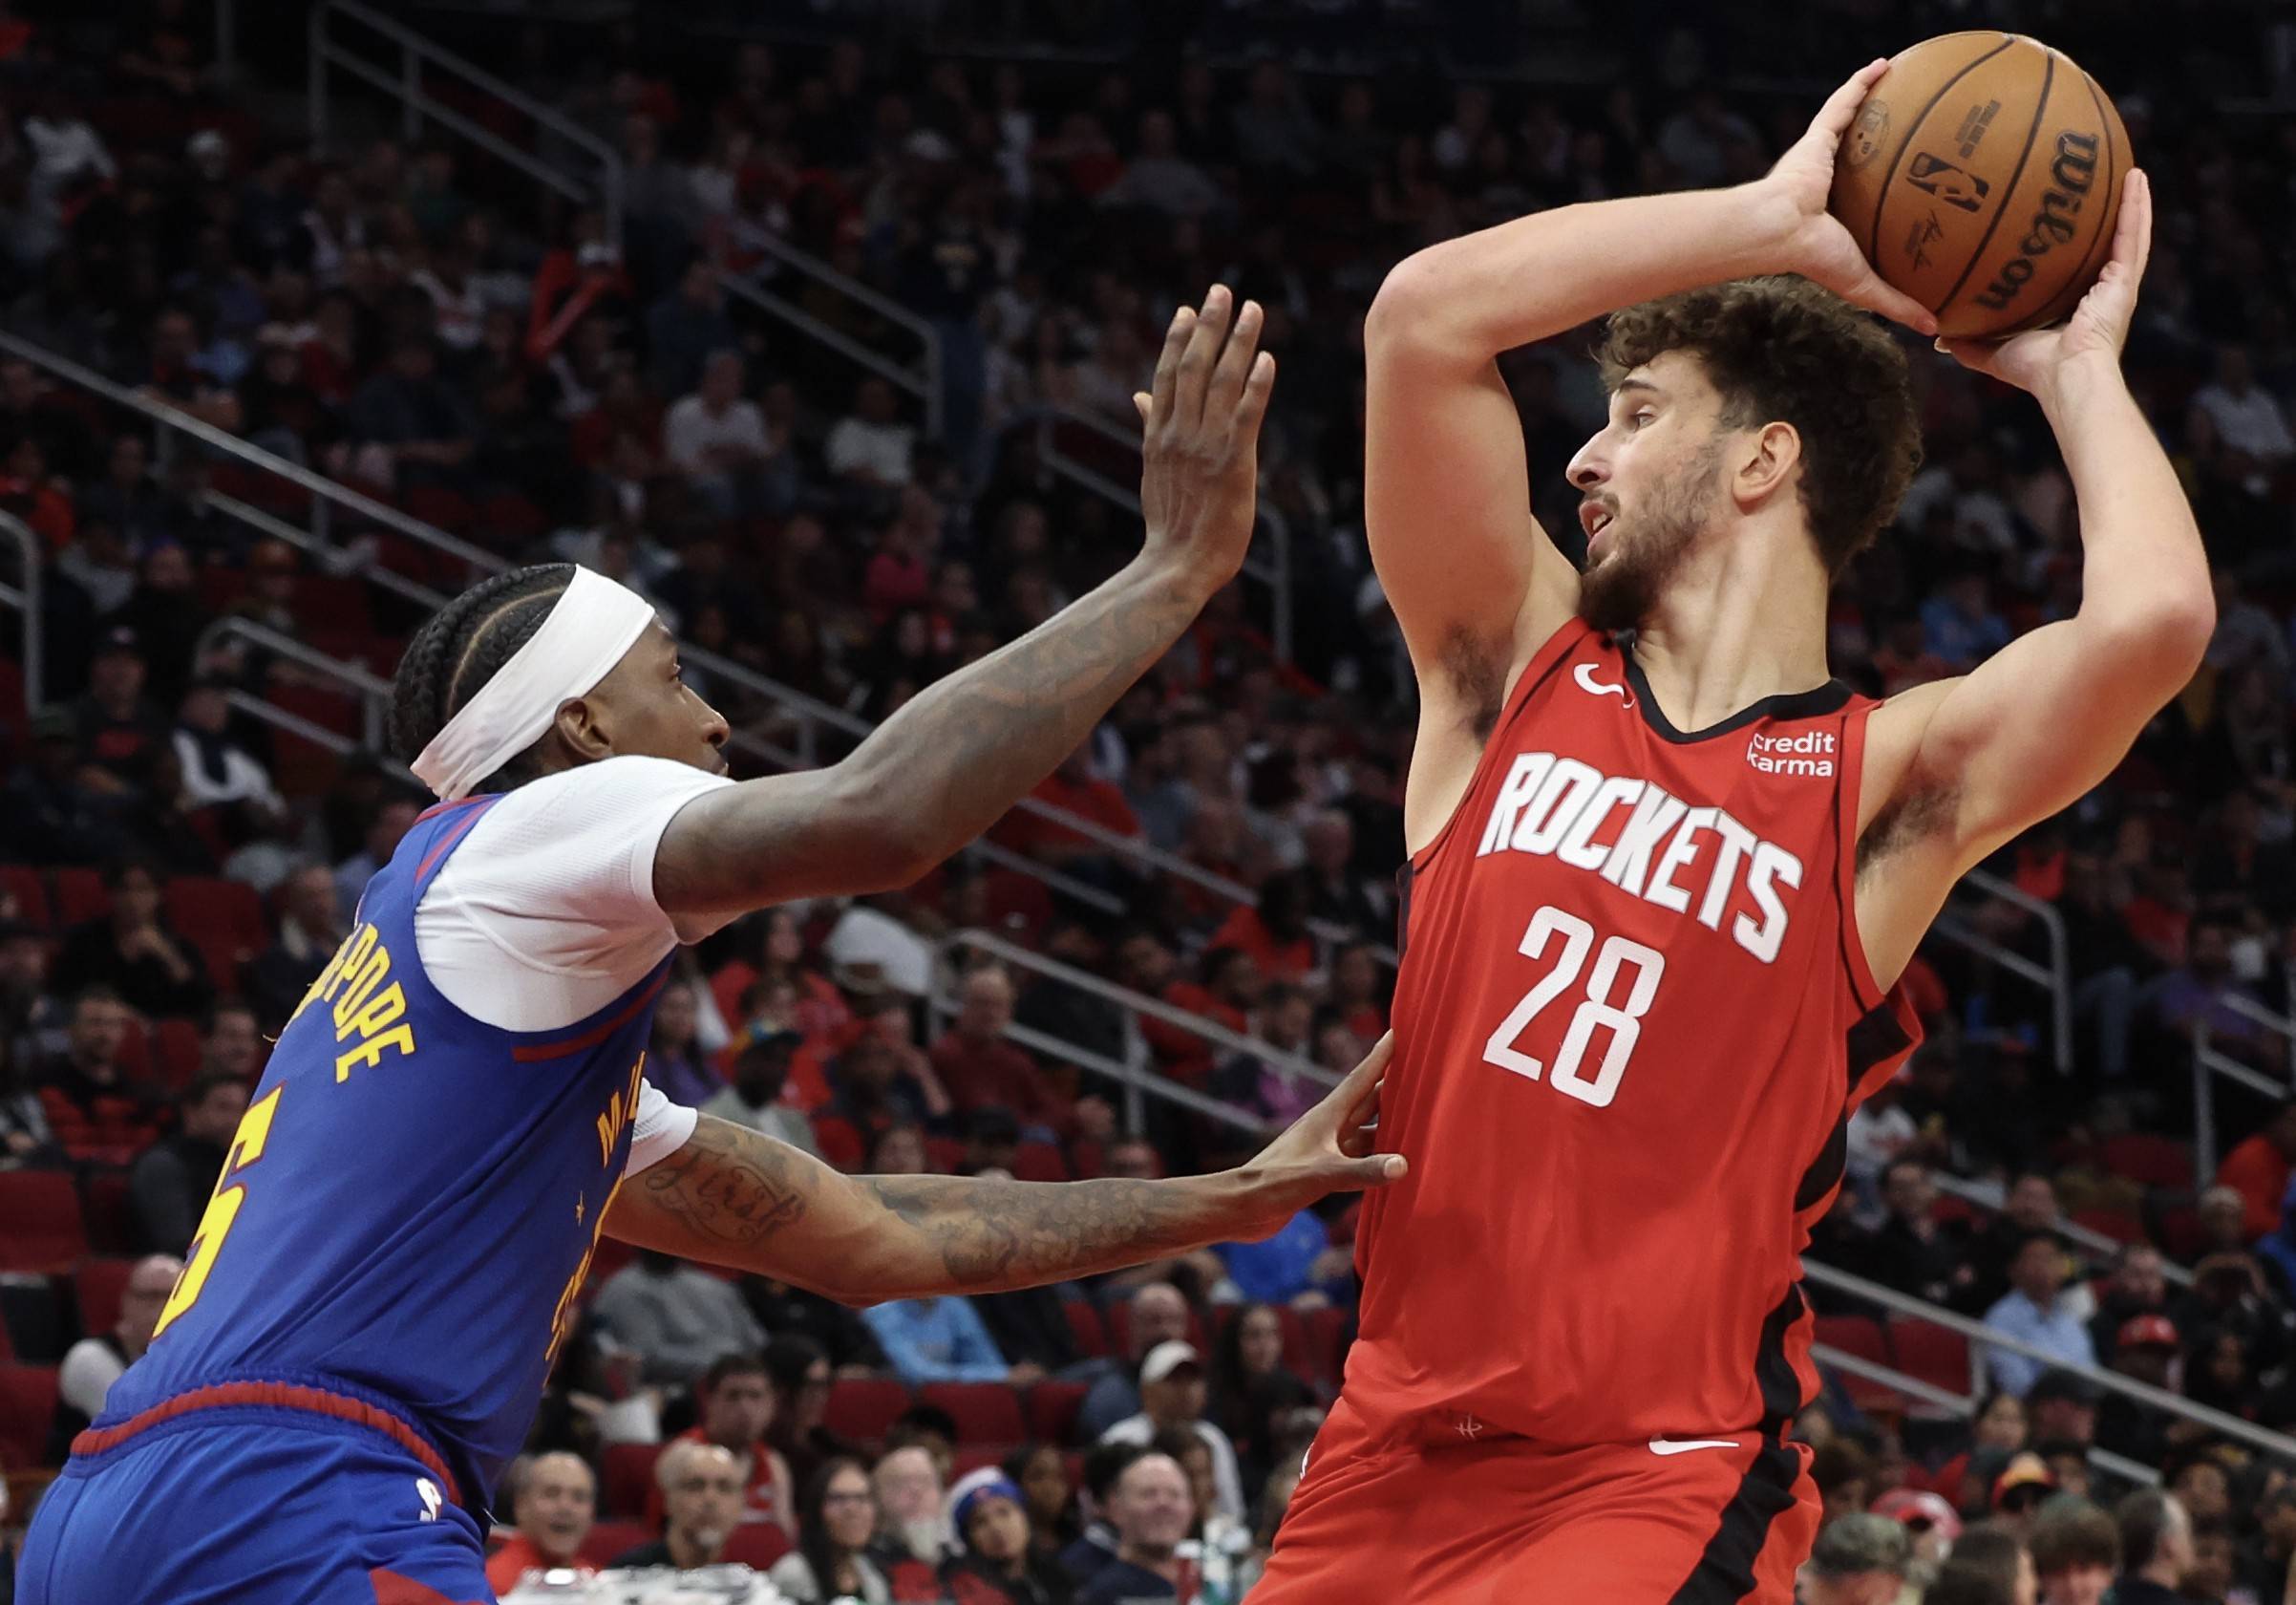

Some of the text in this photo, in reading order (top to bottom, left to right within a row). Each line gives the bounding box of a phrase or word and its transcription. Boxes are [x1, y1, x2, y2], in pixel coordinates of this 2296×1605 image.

[1975, 128, 2100, 310] Wilson
[1753, 731, 1835, 754] credit
[1476, 751, 1804, 965] ROCKETS
[288, 923, 415, 1083] POPE
[1482, 905, 1666, 1108] 28
